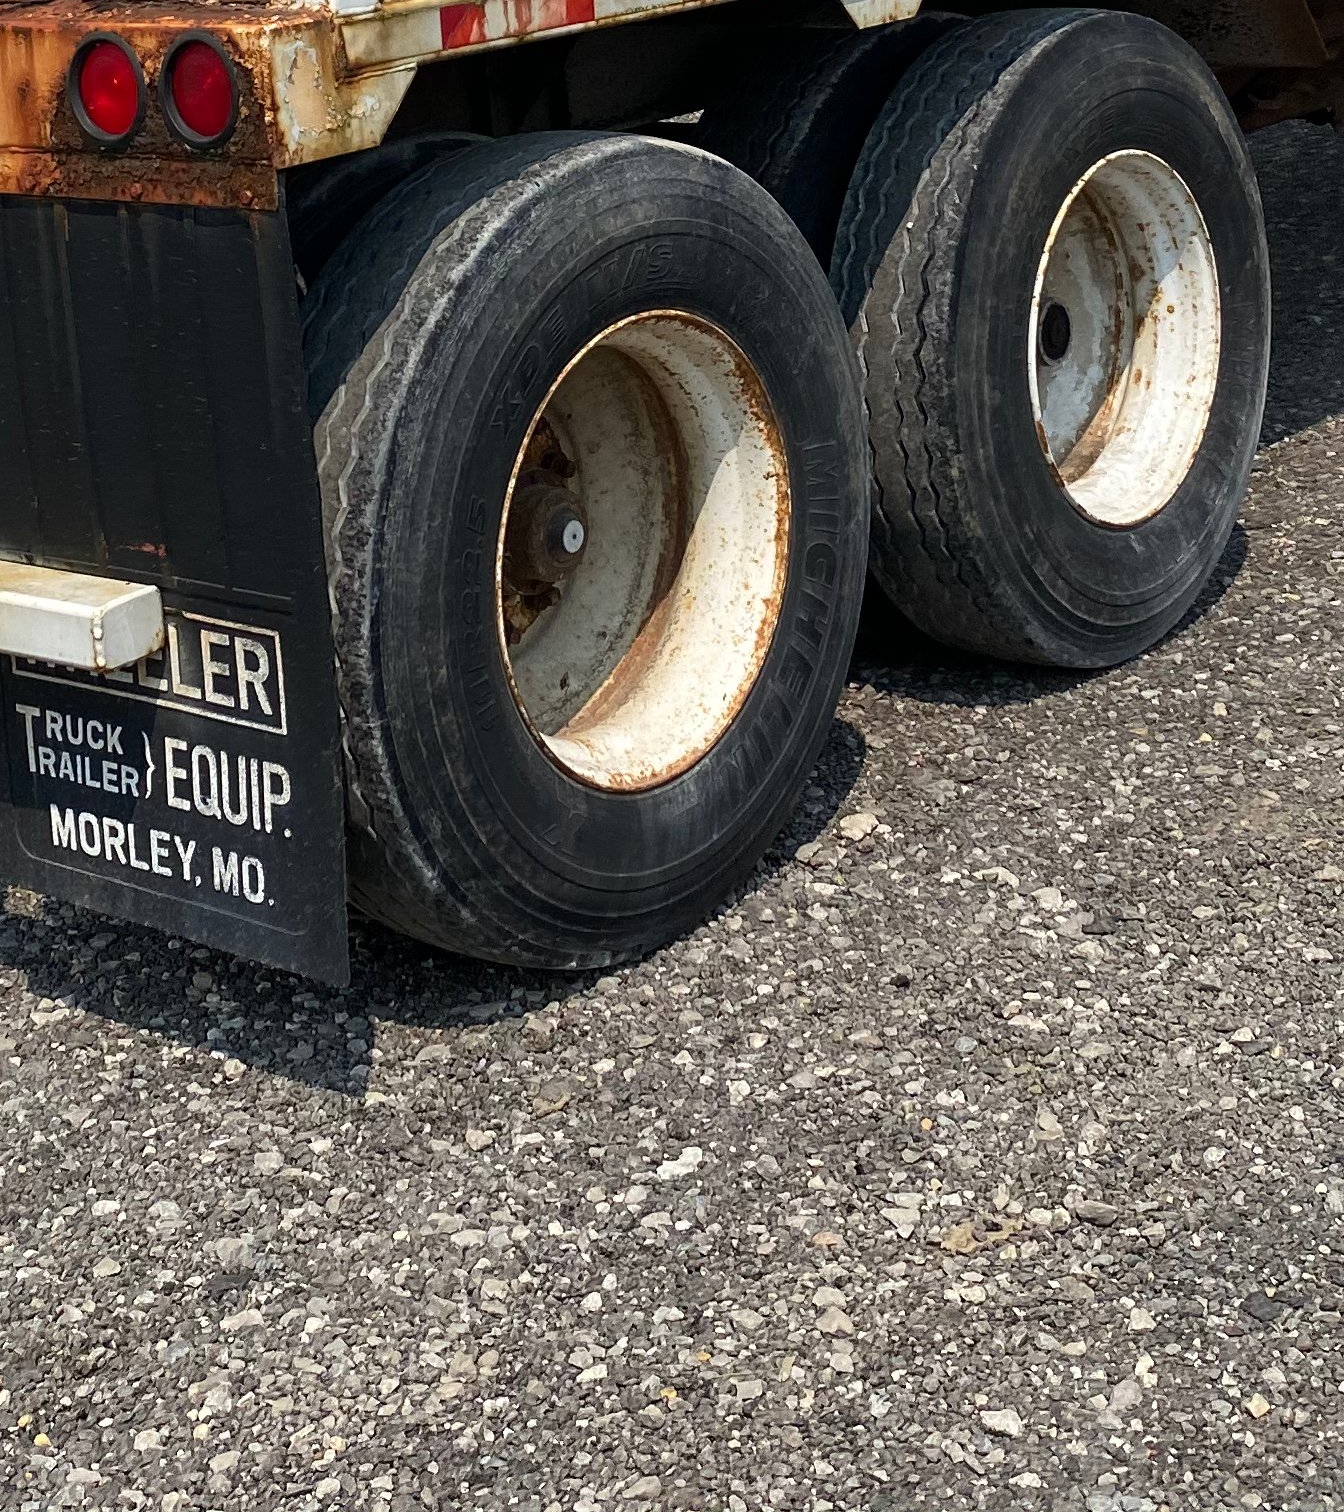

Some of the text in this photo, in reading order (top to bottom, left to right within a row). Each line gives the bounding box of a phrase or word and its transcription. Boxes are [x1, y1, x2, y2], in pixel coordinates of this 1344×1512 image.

[720, 439, 841, 809] MICHELIN
[15, 702, 124, 768] TRUCK
[164, 736, 293, 838] EQUIP.
[49, 803, 275, 907] MORLEY, MO.
